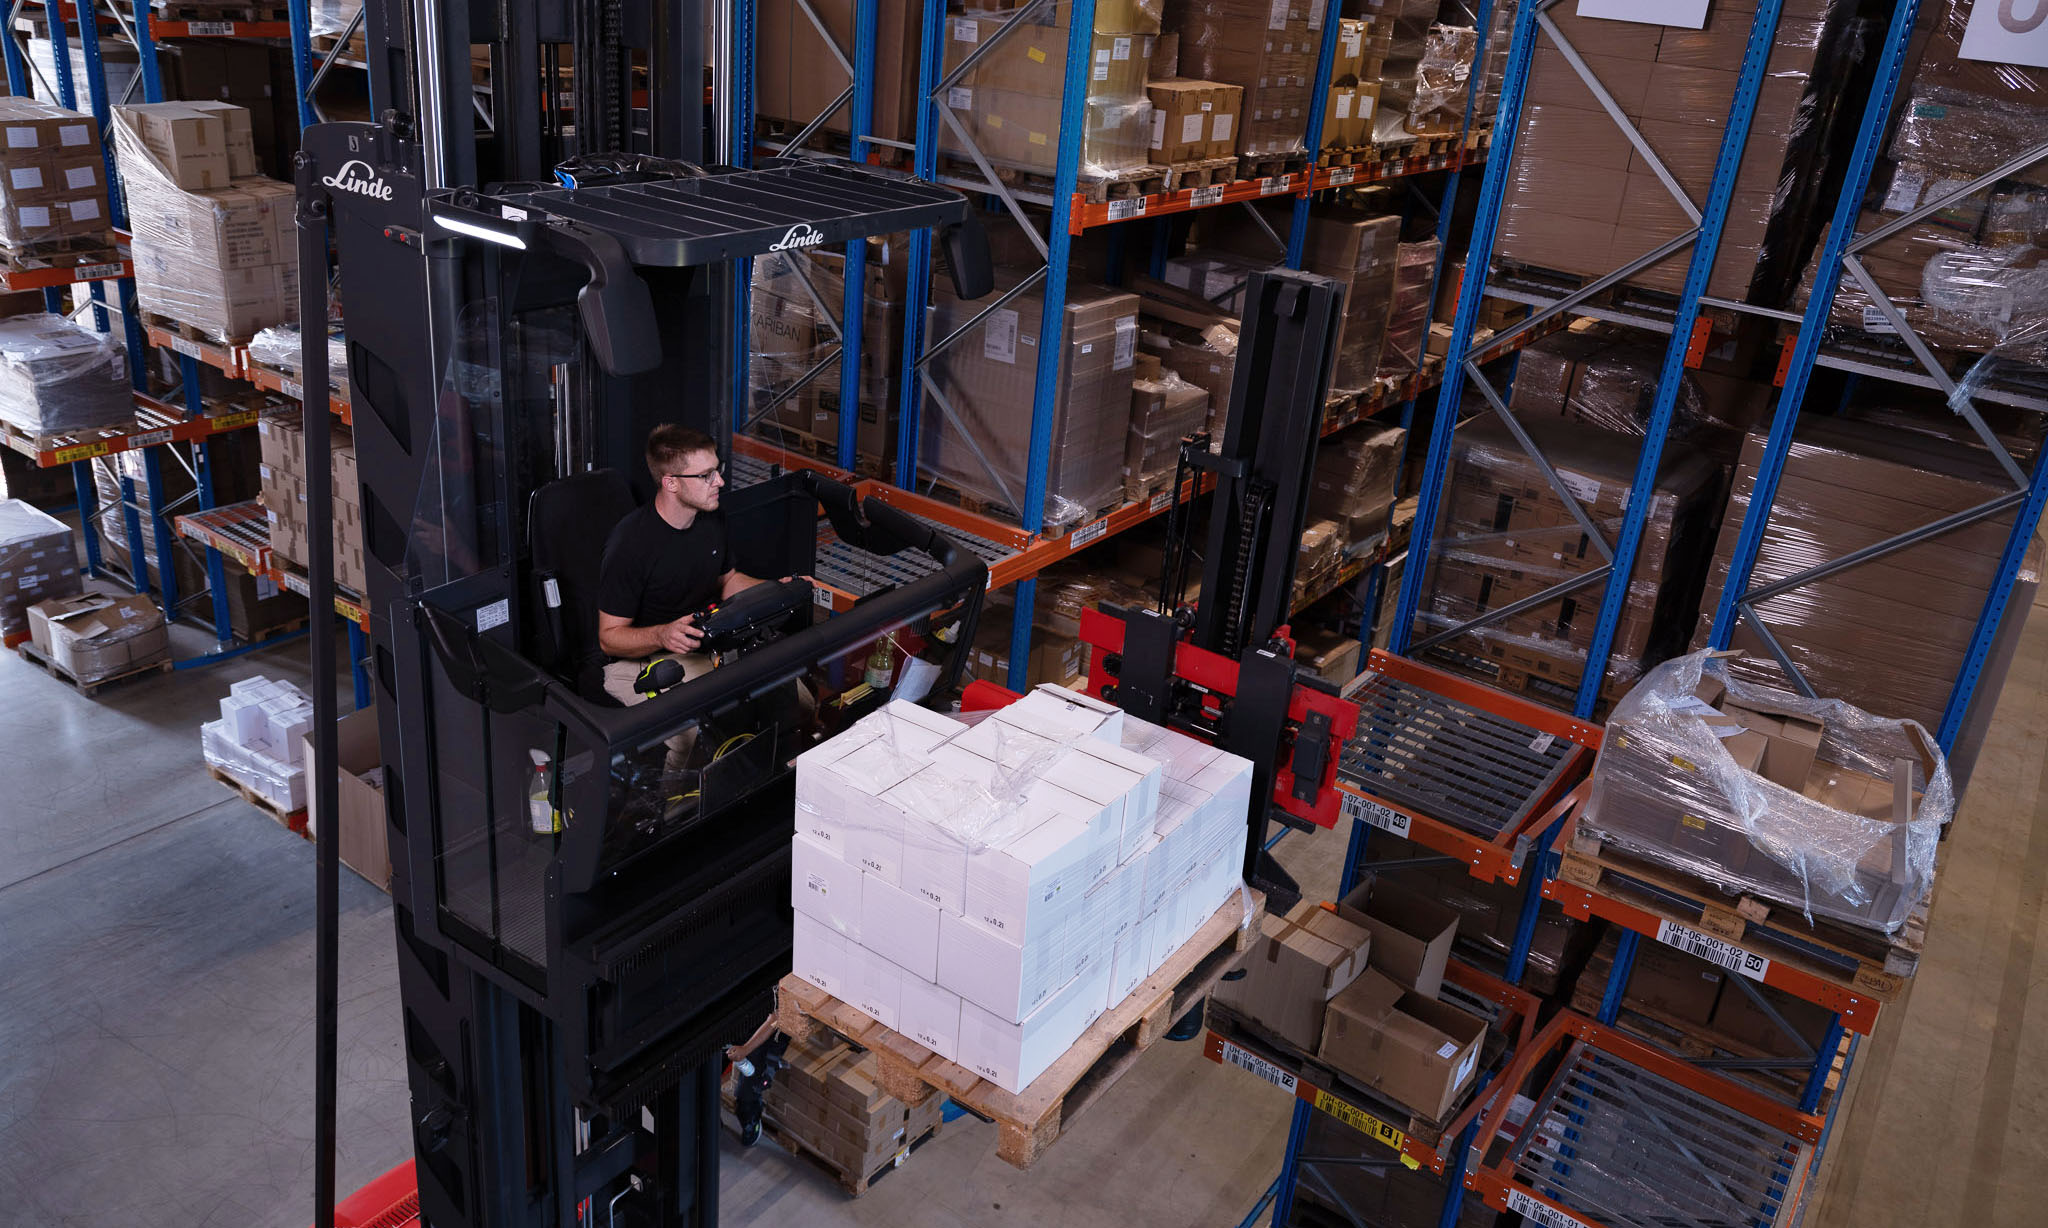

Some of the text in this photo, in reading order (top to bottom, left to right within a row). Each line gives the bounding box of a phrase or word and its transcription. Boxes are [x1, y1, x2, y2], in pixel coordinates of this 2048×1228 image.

[322, 160, 393, 201] Linde
[769, 223, 824, 252] Linde
[1341, 794, 1407, 828] -07-001-02 49
[1668, 922, 1743, 959] UH-06-001-02
[1746, 956, 1762, 970] 50
[1229, 1044, 1295, 1086] UH-07-001-01 72
[1322, 1092, 1378, 1127] UH-07-001-00
[1516, 1192, 1579, 1228] UH-06-001-01
